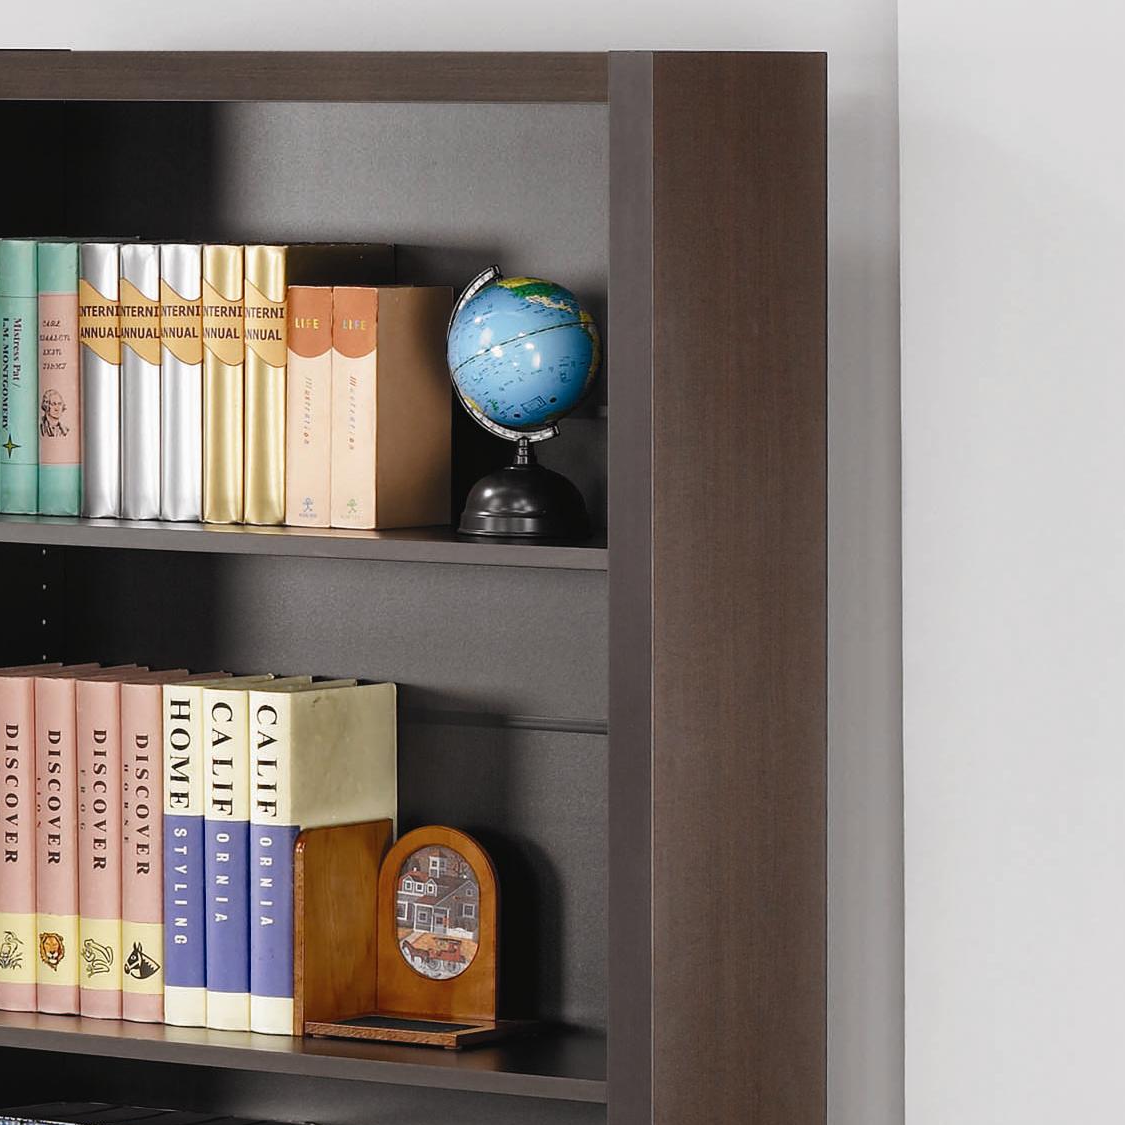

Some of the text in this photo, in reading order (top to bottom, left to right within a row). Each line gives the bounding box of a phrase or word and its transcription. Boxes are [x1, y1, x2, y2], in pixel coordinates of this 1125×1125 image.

[1, 344, 10, 430] MONTGOMERY
[12, 364, 21, 381] Pat
[13, 318, 22, 363] Mistress
[294, 317, 319, 329] LIFE
[342, 319, 366, 330] LIFE
[5, 724, 19, 863] DISCOVER
[47, 730, 61, 864] DISCOVER
[93, 729, 107, 870] DISCOVER
[135, 734, 150, 875] DISCOVER
[169, 699, 191, 944] HOME STYLING
[211, 701, 233, 922] CALIF ORNIA
[256, 704, 277, 926] CALIF ORNIA
